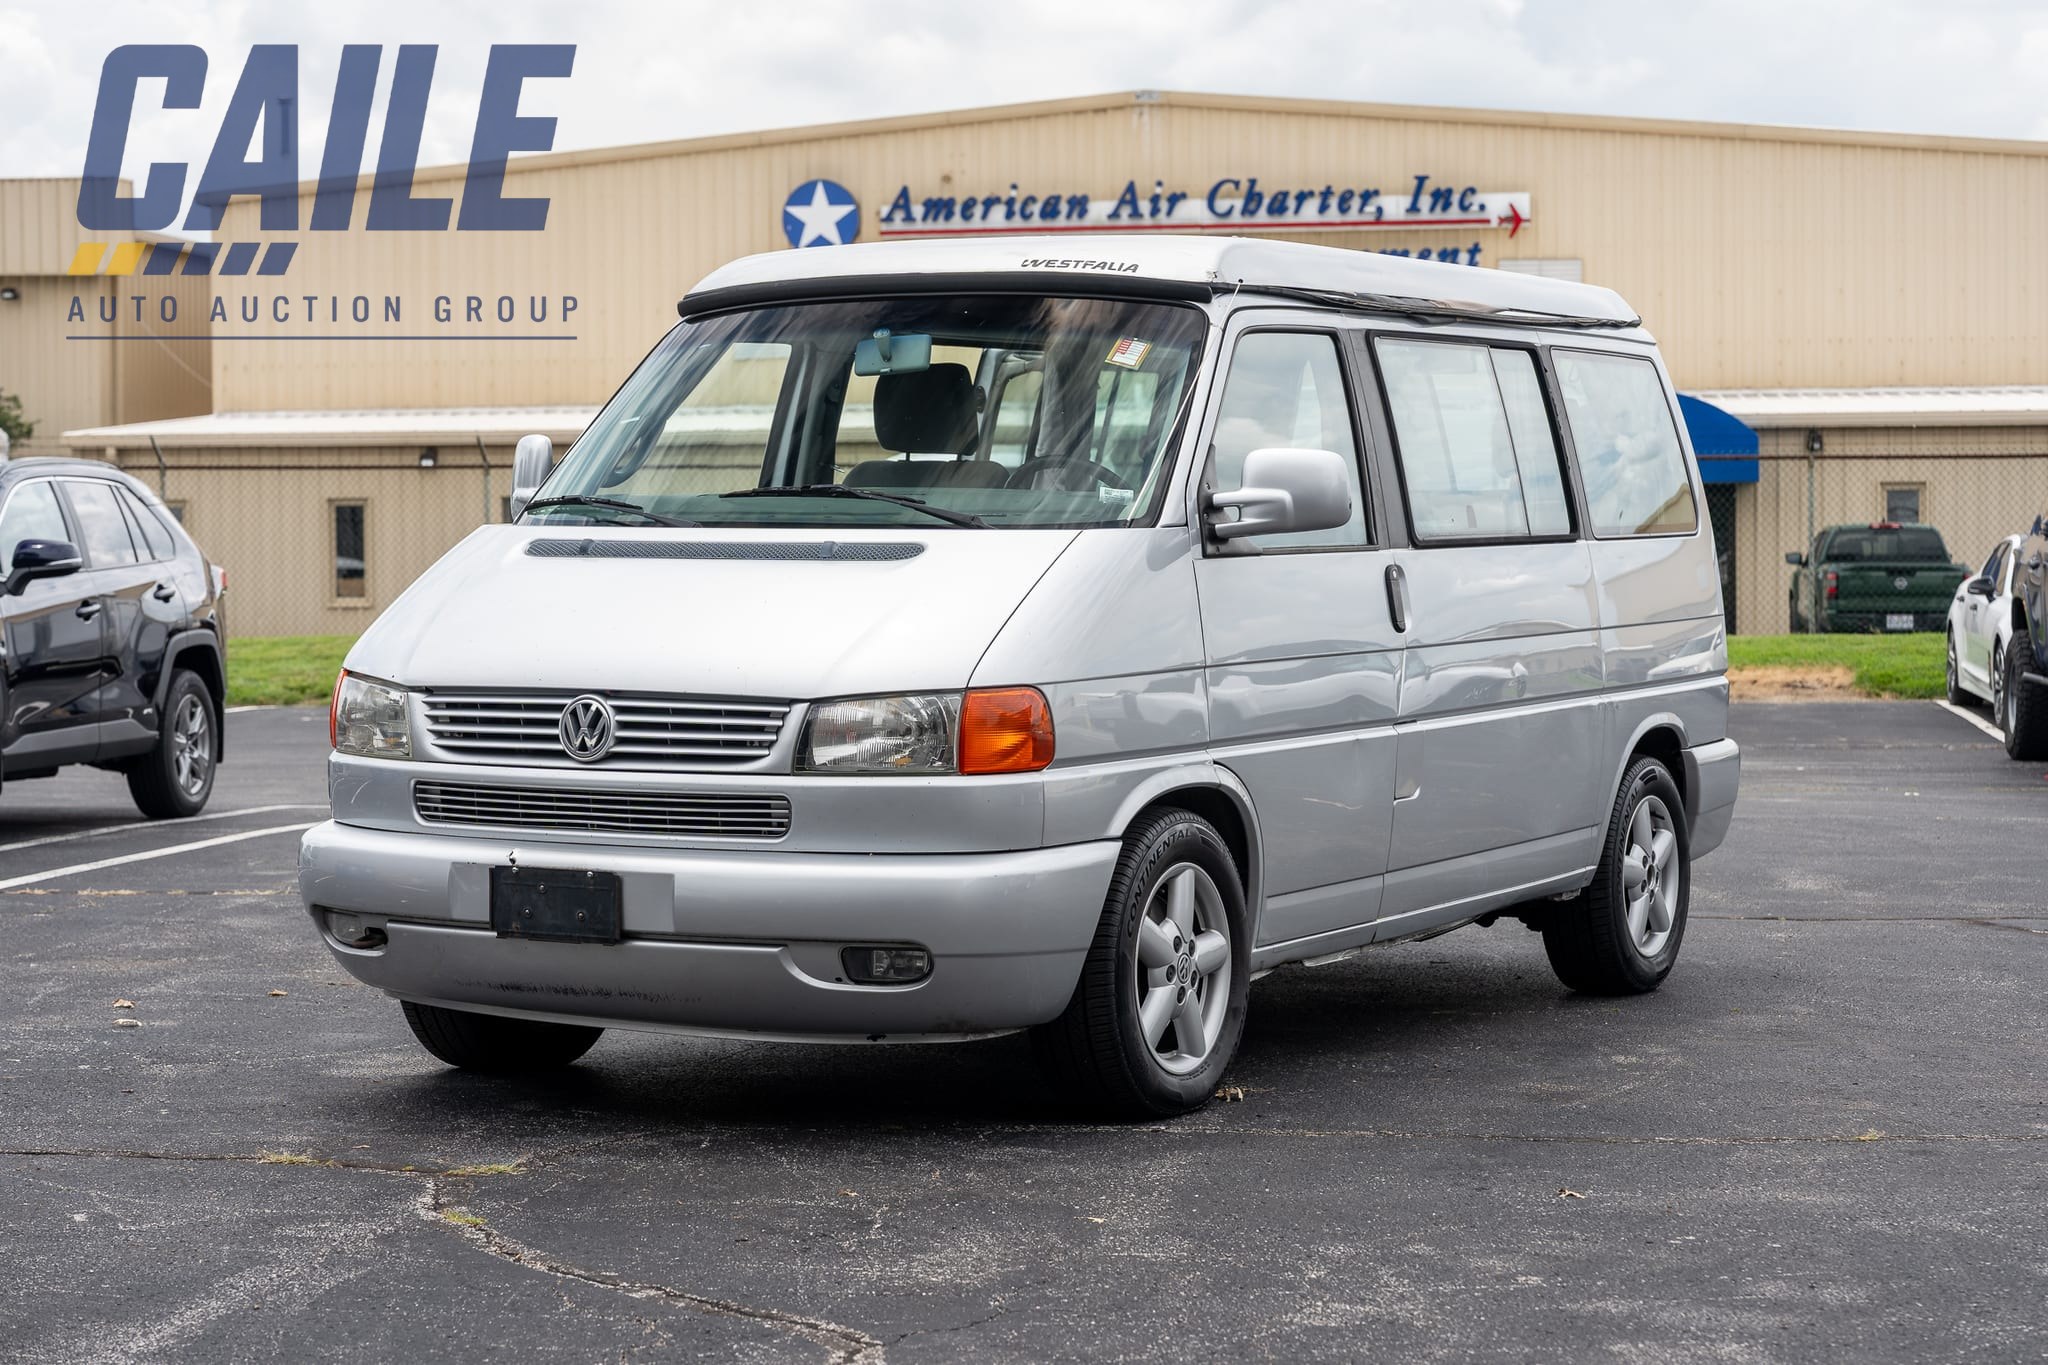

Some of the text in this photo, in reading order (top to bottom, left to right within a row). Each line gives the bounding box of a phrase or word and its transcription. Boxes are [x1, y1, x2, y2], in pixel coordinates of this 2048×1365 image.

[880, 175, 1487, 223] American Air Charter, Inc.
[1020, 259, 1140, 273] WESTFALIA
[1127, 828, 1192, 938] CONTINENTAL
